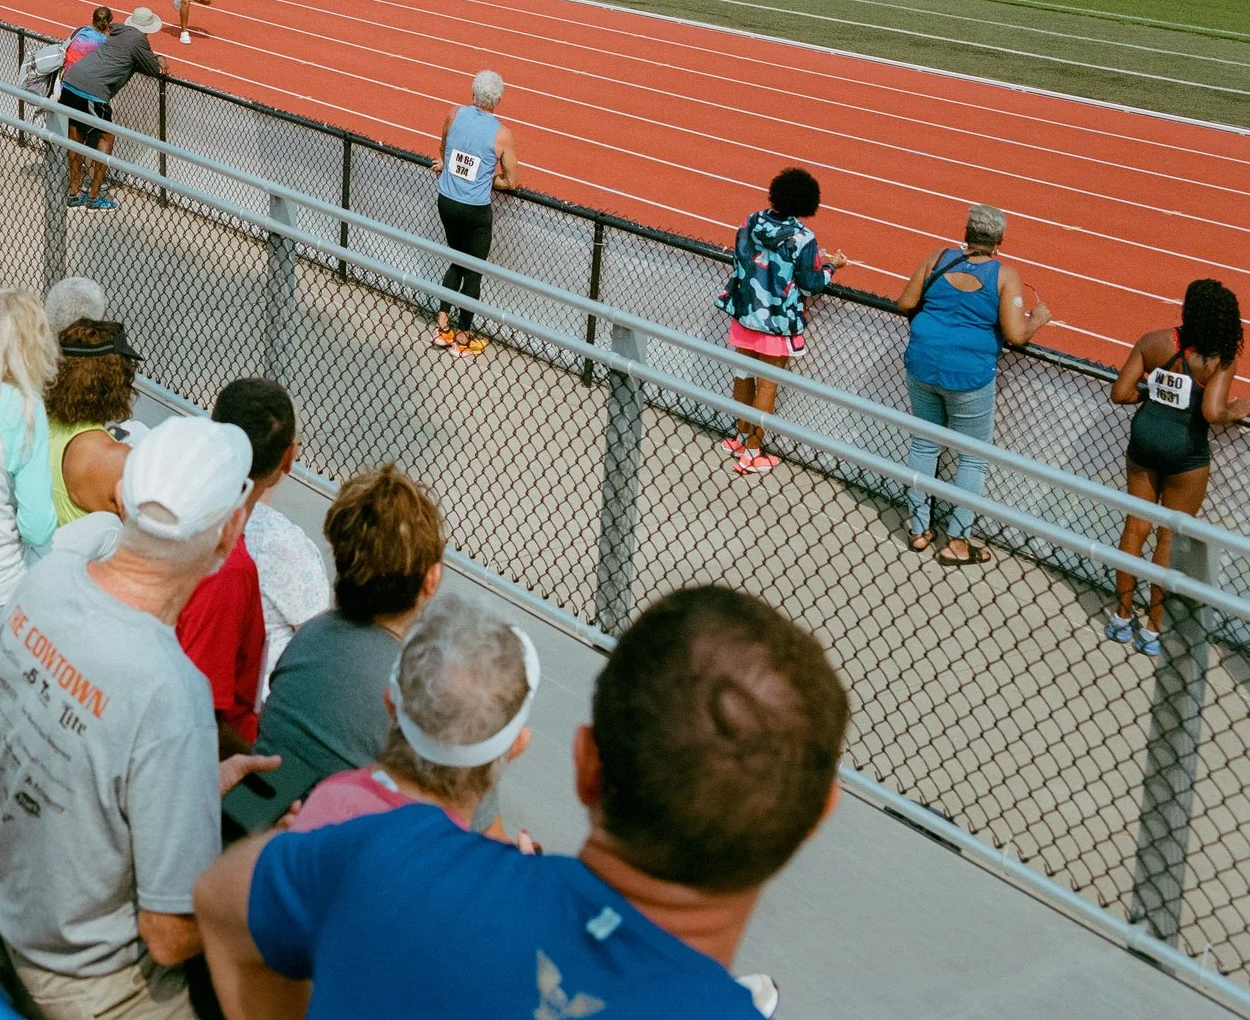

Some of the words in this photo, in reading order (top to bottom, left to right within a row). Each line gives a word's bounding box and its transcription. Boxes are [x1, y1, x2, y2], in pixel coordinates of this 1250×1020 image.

[455, 152, 464, 163] M
[464, 156, 475, 167] 65
[455, 164, 469, 177] 374
[1154, 371, 1164, 384] W
[1166, 375, 1184, 390] 60
[1156, 387, 1180, 405] 1631
[23, 626, 111, 721] COWTOWN
